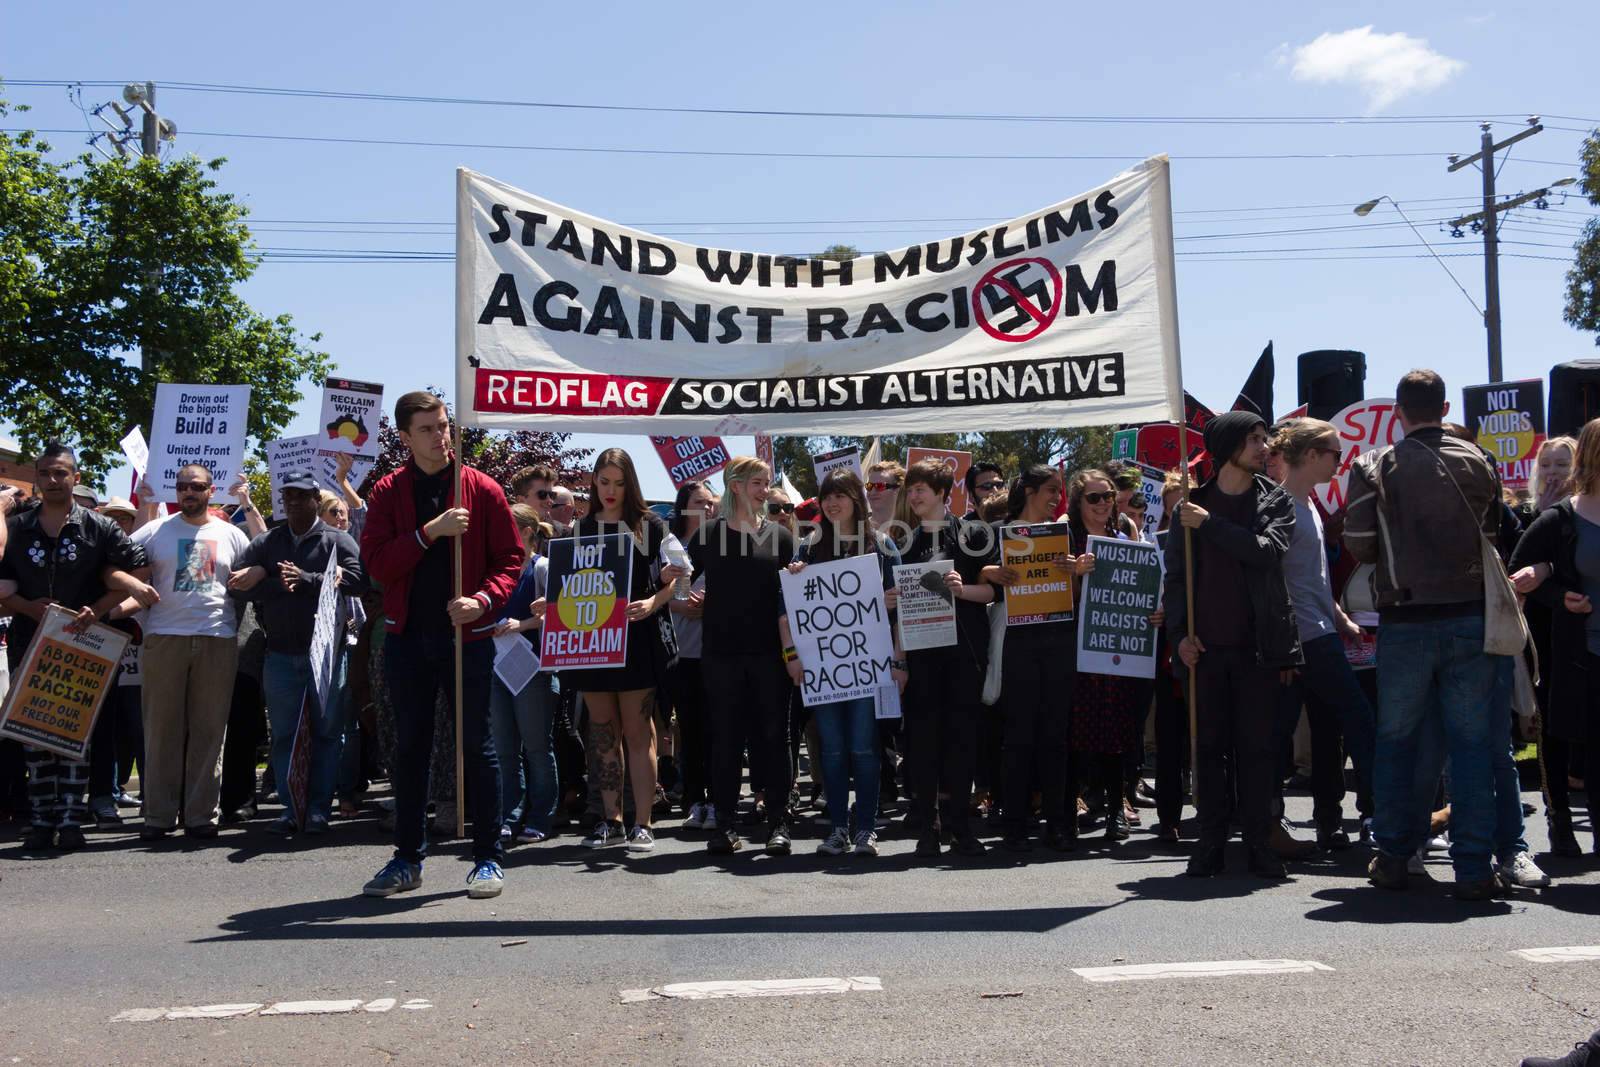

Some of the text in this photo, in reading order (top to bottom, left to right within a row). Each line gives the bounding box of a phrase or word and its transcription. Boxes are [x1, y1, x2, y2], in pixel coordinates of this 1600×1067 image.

[488, 189, 1120, 288] STAND WITH MUSLIMS
[477, 272, 784, 344] AGAINST
[487, 357, 1120, 409] REDFLAG SOCIALIST ALTERNATIVE
[180, 393, 229, 404] Drown out
[330, 394, 375, 408] RECLAIM
[1487, 389, 1519, 411] NOT
[178, 404, 229, 416] the bigots:
[335, 404, 369, 416] WHAT?
[175, 416, 227, 434] Build a
[1478, 411, 1531, 435] YOURS
[166, 444, 230, 455] United Front
[274, 448, 316, 460] Austerity
[279, 441, 299, 450] War
[675, 435, 705, 459] OUR
[1496, 437, 1518, 458] TO
[177, 458, 217, 469] to stop
[297, 457, 312, 465] the
[671, 445, 727, 482] STREETS!
[823, 459, 853, 472] ALWAYS
[573, 544, 606, 569] NOT
[1096, 545, 1158, 567] MUSLIMS
[1026, 568, 1049, 578] ARE
[1111, 568, 1139, 586] ARE
[561, 571, 615, 598] YOURS
[803, 570, 861, 601] #NO
[1010, 581, 1067, 595] WELCOME
[1090, 587, 1155, 609] WELCOME
[575, 601, 597, 625] TO
[795, 597, 881, 635] ROOM
[1091, 610, 1148, 631] RACISTS
[545, 628, 623, 656] RECLAIM
[816, 631, 869, 662] FOR
[1089, 632, 1147, 652] ARE NOT
[43, 645, 107, 677] ABOLISH
[37, 658, 100, 689] WAR AND
[803, 656, 893, 695] RACISM
[28, 674, 95, 708] RACISM
[31, 696, 81, 720] NOT OUR
[22, 706, 81, 733] FREEDOMS
